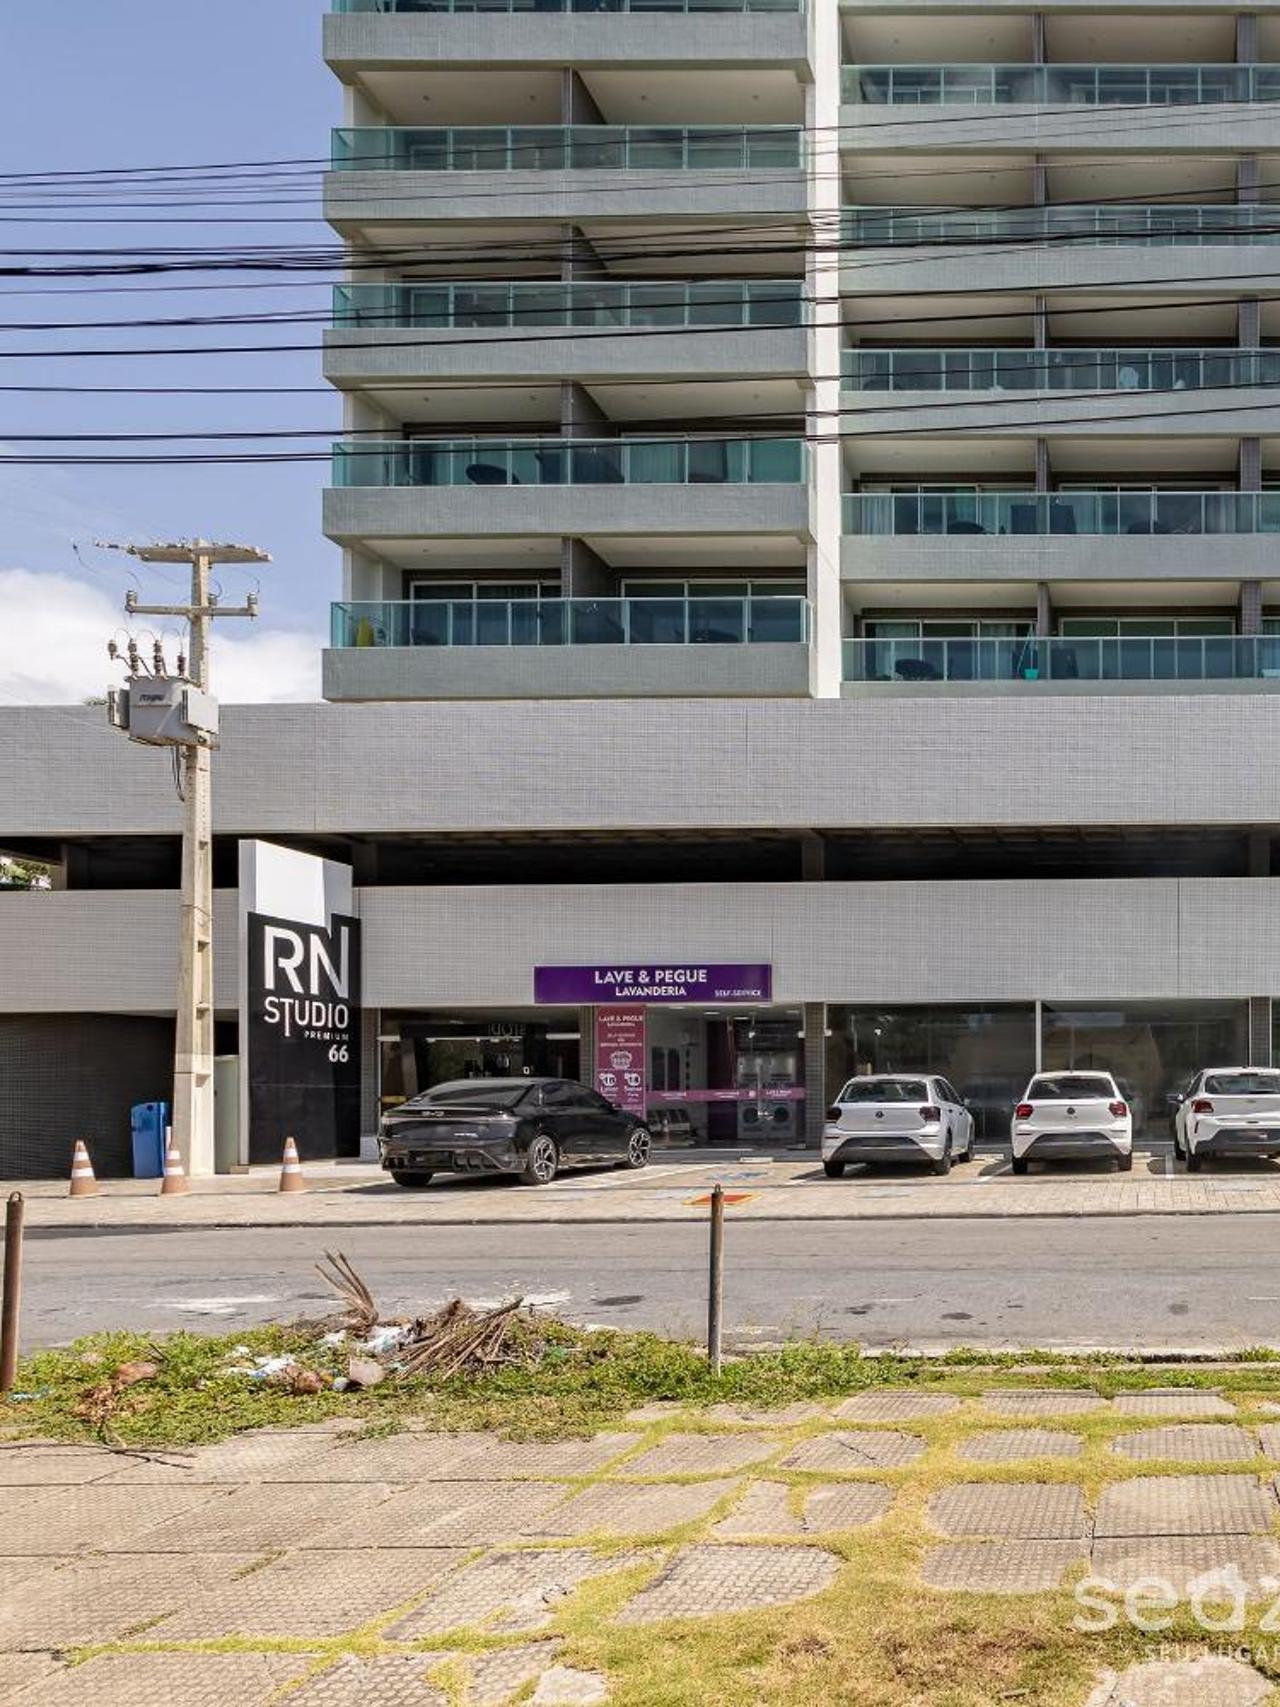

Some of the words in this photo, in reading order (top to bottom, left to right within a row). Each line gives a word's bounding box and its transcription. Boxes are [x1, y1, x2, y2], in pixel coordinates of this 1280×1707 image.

[264, 924, 350, 999] RN
[594, 970, 634, 984] LAVE
[639, 970, 650, 984] &
[654, 969, 707, 983] PEGUE
[615, 986, 687, 997] LAVANDERIA
[264, 996, 349, 1037] STUDIO
[304, 1030, 349, 1041] PREMIUM
[328, 1044, 349, 1063] 66
